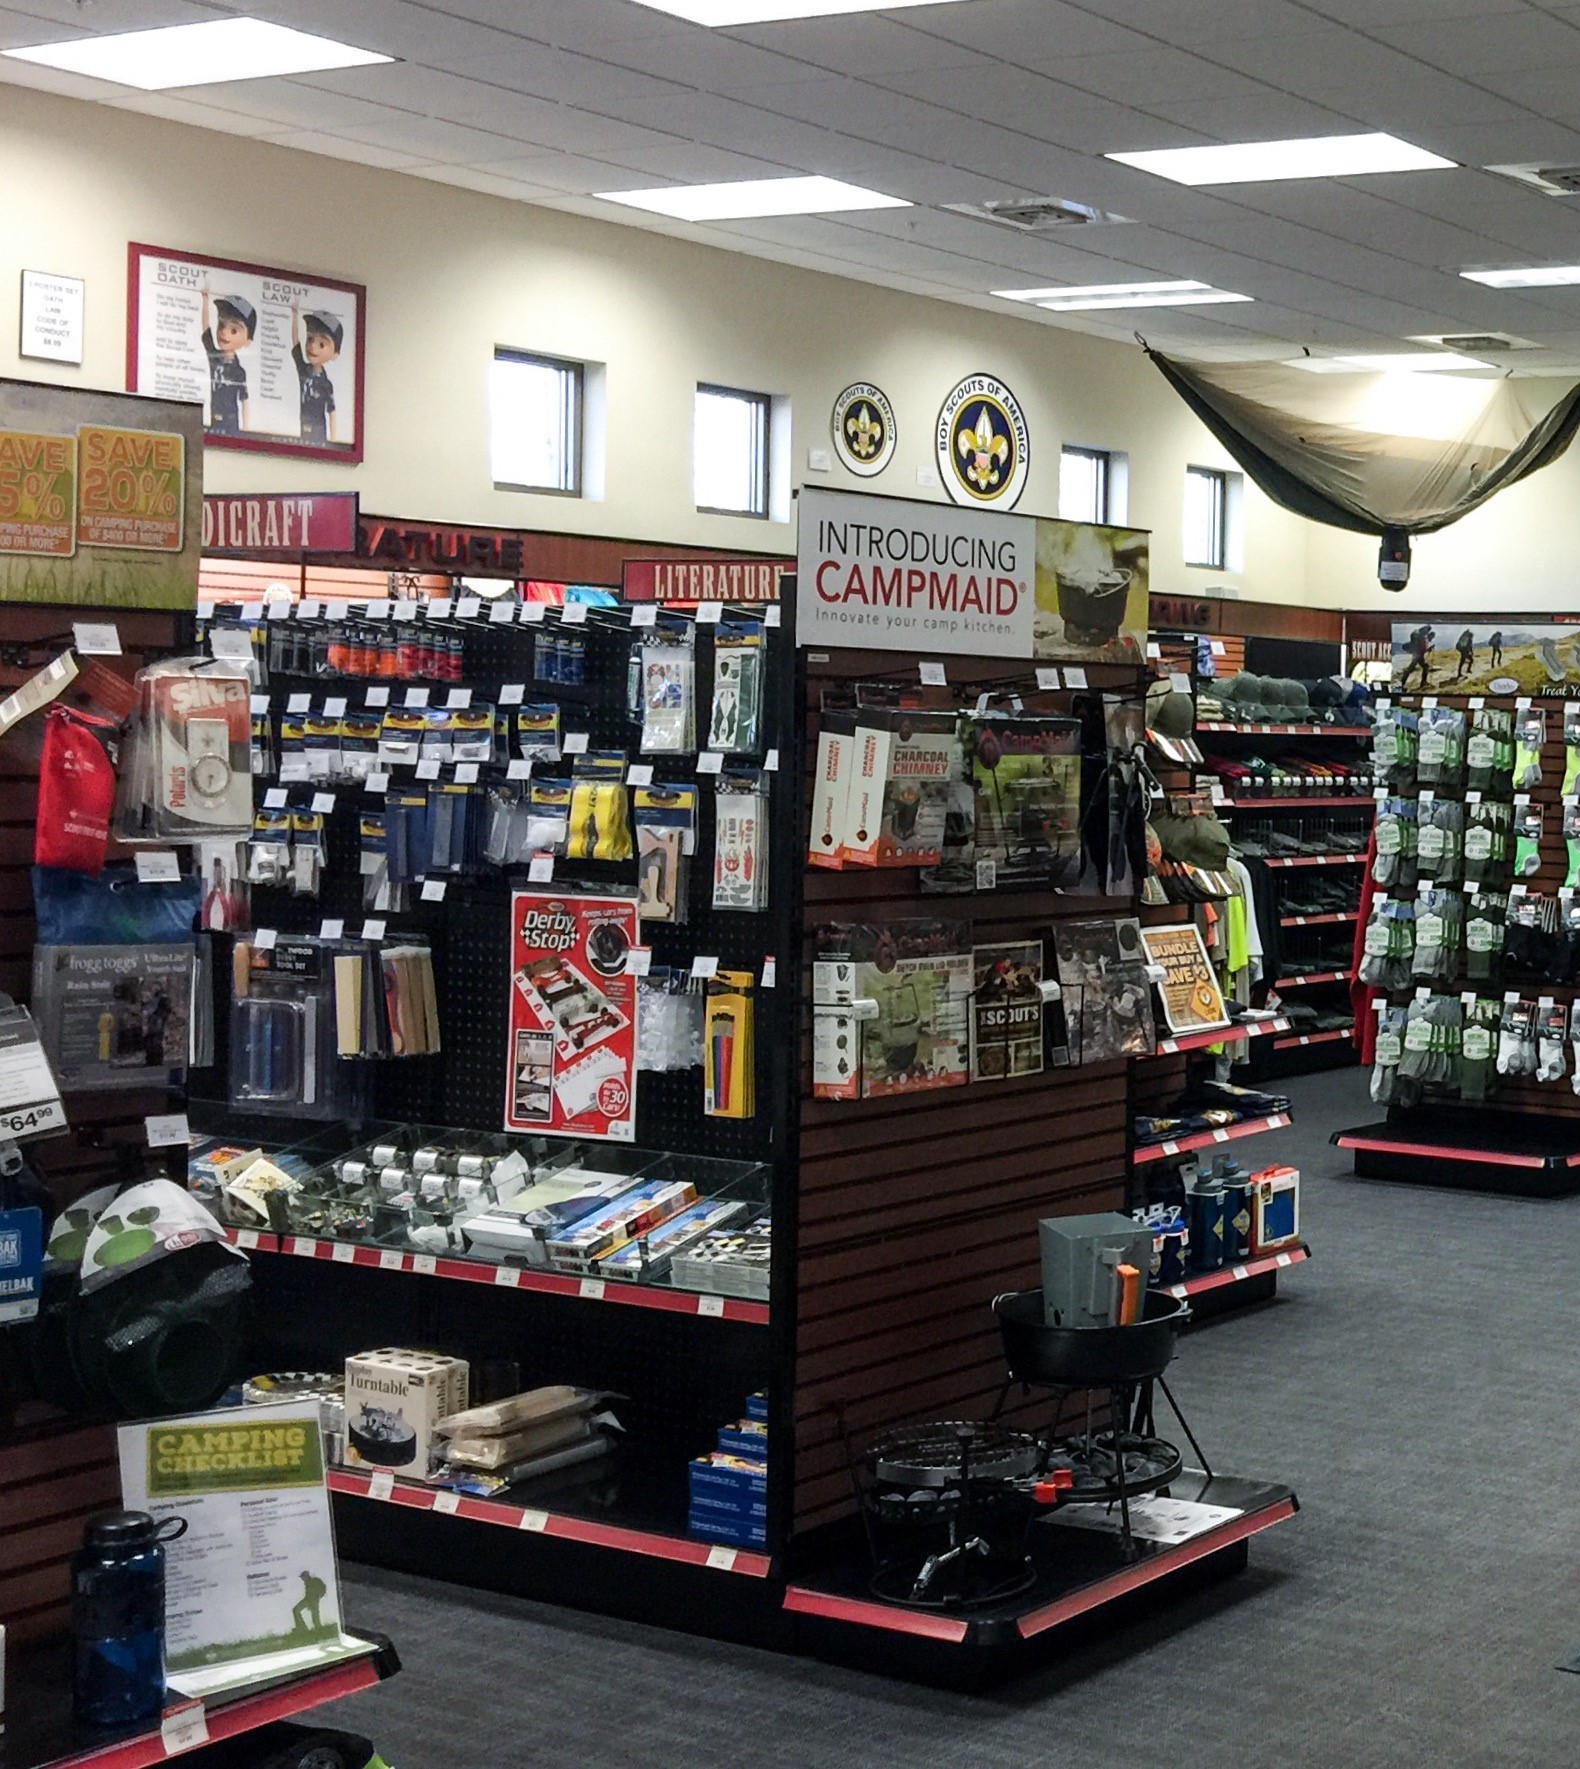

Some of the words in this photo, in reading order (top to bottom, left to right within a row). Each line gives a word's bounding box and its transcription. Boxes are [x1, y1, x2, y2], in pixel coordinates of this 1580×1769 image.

[157, 262, 209, 279] SCOUT
[157, 273, 197, 287] OATH
[262, 281, 310, 298] SCOUT
[262, 292, 292, 304] LAW
[839, 386, 865, 409] SCOUTS
[866, 388, 878, 397] OF
[939, 418, 949, 451] BOY
[946, 379, 985, 415] SCOUTS
[987, 382, 1002, 396] OF
[1002, 395, 1027, 464] AMERICA
[87, 432, 173, 470] SAVE
[83, 466, 177, 516] 20%
[819, 520, 1016, 573] INTRODUCING
[816, 608, 880, 626] Innovate
[886, 615, 918, 630] your
[923, 617, 958, 634] camp
[963, 619, 1015, 635] kitchen.
[1540, 684, 1567, 697] Treat
[893, 751, 949, 763] CHARCOAL
[892, 762, 948, 776] CHIMNEY
[169, 766, 187, 808] Polaris
[524, 910, 576, 934] Derby
[529, 930, 571, 953] Stop
[1150, 941, 1200, 958] BUNDLE
[69, 955, 102, 974] frogg
[103, 957, 138, 974] toggs
[609, 1090, 626, 1104] 30
[350, 1373, 409, 1397] Turntable
[157, 1427, 307, 1456] CAMPING
[156, 1448, 305, 1473] CHECKLIST
